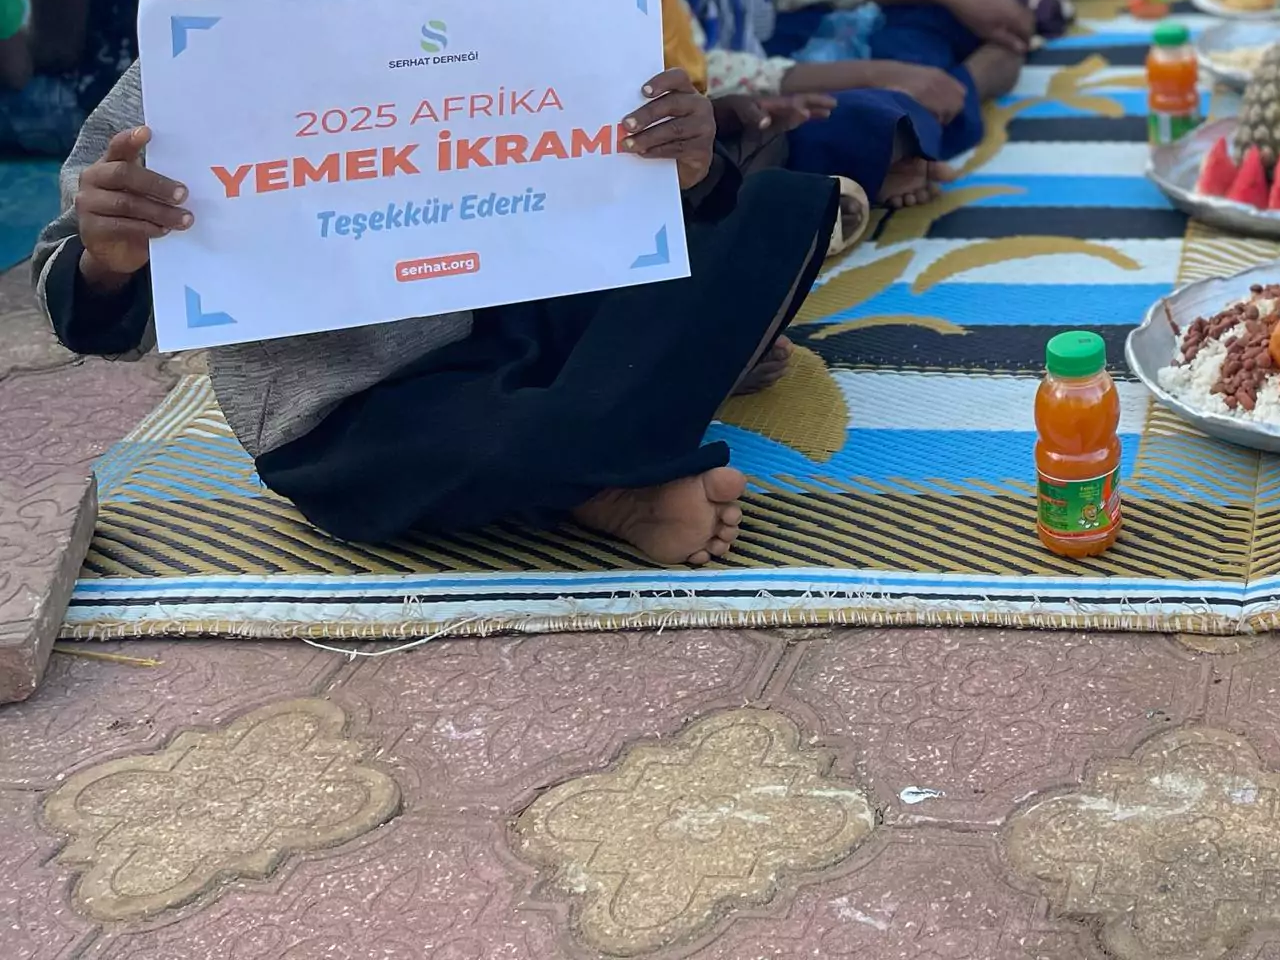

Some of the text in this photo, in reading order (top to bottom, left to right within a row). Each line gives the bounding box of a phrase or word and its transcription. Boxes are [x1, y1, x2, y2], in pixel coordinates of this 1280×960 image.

[388, 57, 430, 69] SERHAT
[295, 86, 564, 137] 2025 AFRİKA
[210, 143, 421, 199] YEMEK
[317, 187, 547, 240] Teşekkür Ederiz
[401, 258, 475, 277] serhat.org
